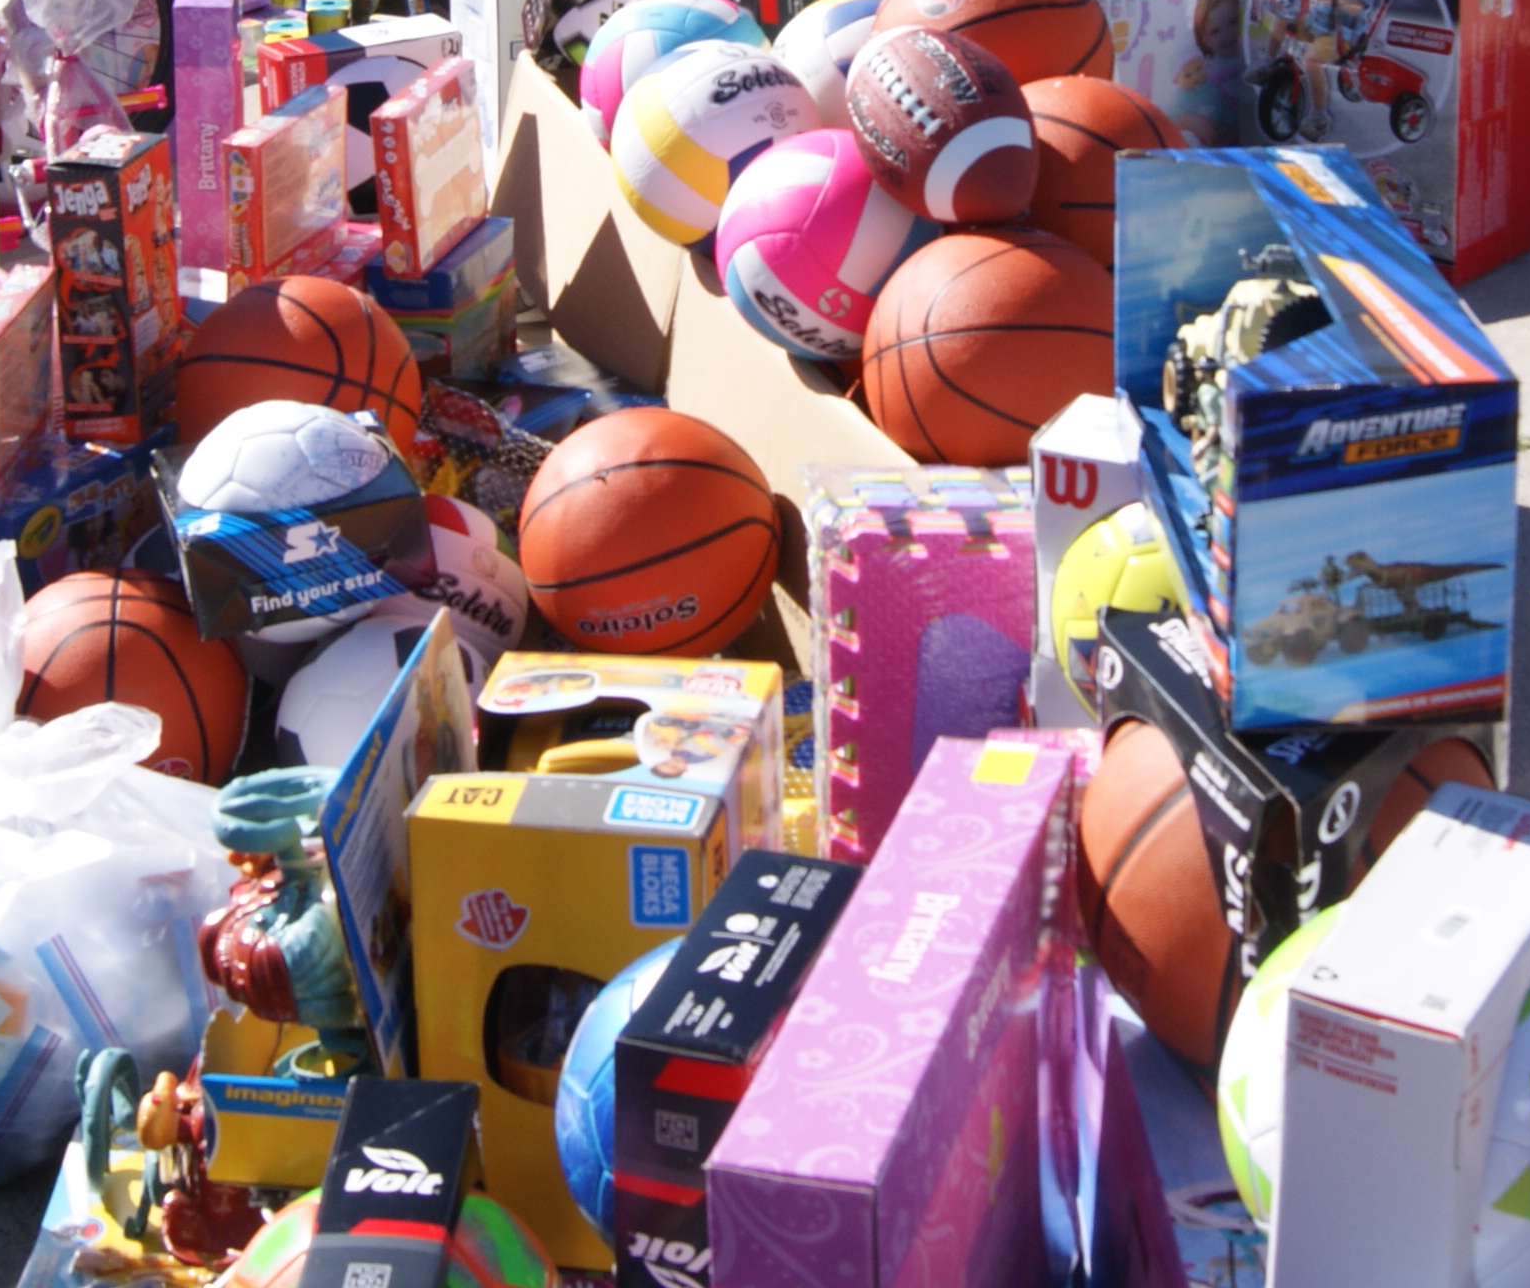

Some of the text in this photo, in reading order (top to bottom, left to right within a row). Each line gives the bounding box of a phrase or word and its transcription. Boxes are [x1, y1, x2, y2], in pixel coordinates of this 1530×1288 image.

[198, 121, 221, 191] Brittany
[52, 179, 111, 216] Jenga
[1295, 400, 1468, 460] ADVENTURE
[251, 569, 386, 615] Find your star
[576, 594, 700, 636] Soleiro
[443, 784, 505, 808] CAT
[640, 852, 658, 917] BLOKS
[662, 852, 680, 917] MEGA
[224, 1083, 346, 1111] imaginex
[342, 1165, 445, 1196] Voit
